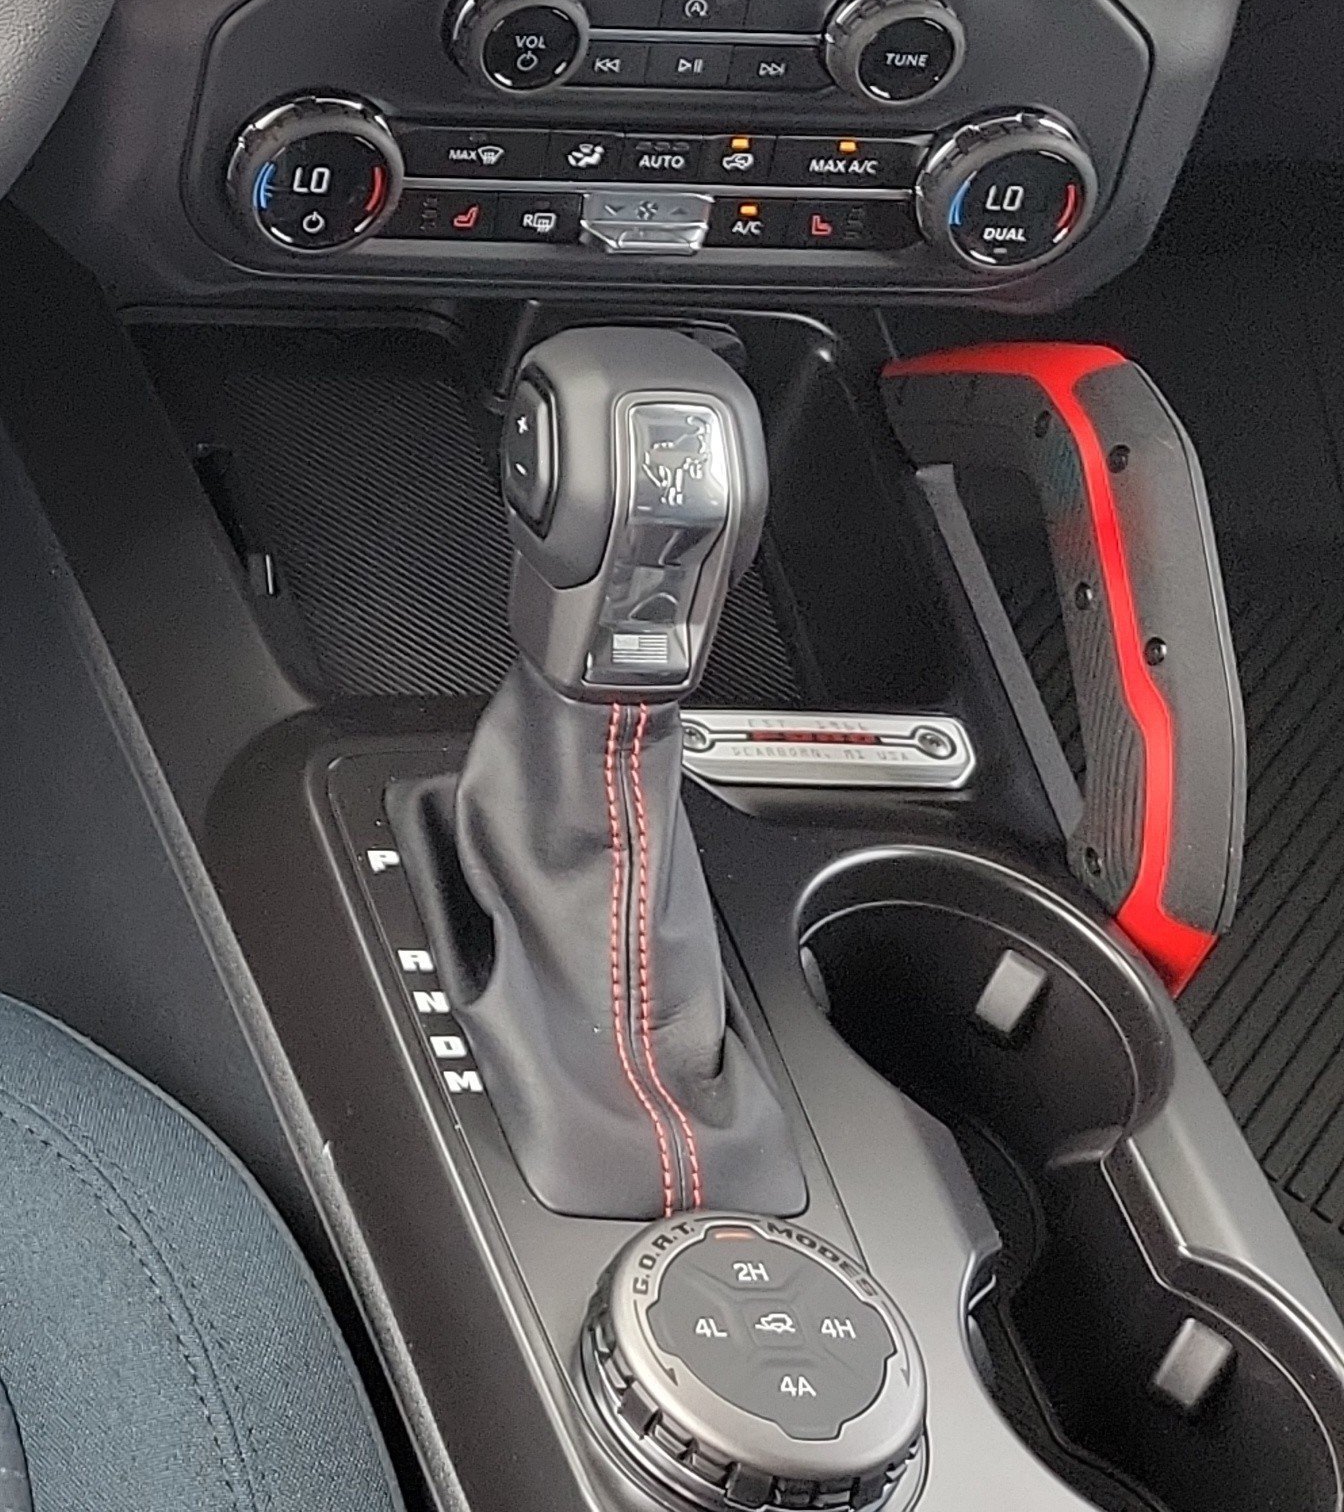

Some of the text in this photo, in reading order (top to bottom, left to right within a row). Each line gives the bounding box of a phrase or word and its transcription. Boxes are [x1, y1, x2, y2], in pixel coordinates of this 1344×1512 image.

[515, 35, 546, 50] VOL
[885, 52, 929, 68] TUNE
[448, 148, 477, 161] MAX
[638, 155, 686, 170] AUTO
[809, 159, 879, 175] MAX A/C
[292, 166, 330, 194] LO
[985, 185, 1025, 212] LO
[732, 220, 762, 236] A/C
[982, 227, 1027, 243] DUAL
[366, 849, 400, 873] P
[413, 991, 450, 1013] N
[429, 1036, 467, 1059] D
[443, 1070, 484, 1093] M
[767, 1223, 879, 1297] MODES
[732, 1263, 770, 1282] 2H
[695, 1318, 728, 1338] 4L
[820, 1318, 857, 1339] 4H
[780, 1376, 817, 1397] 4A
